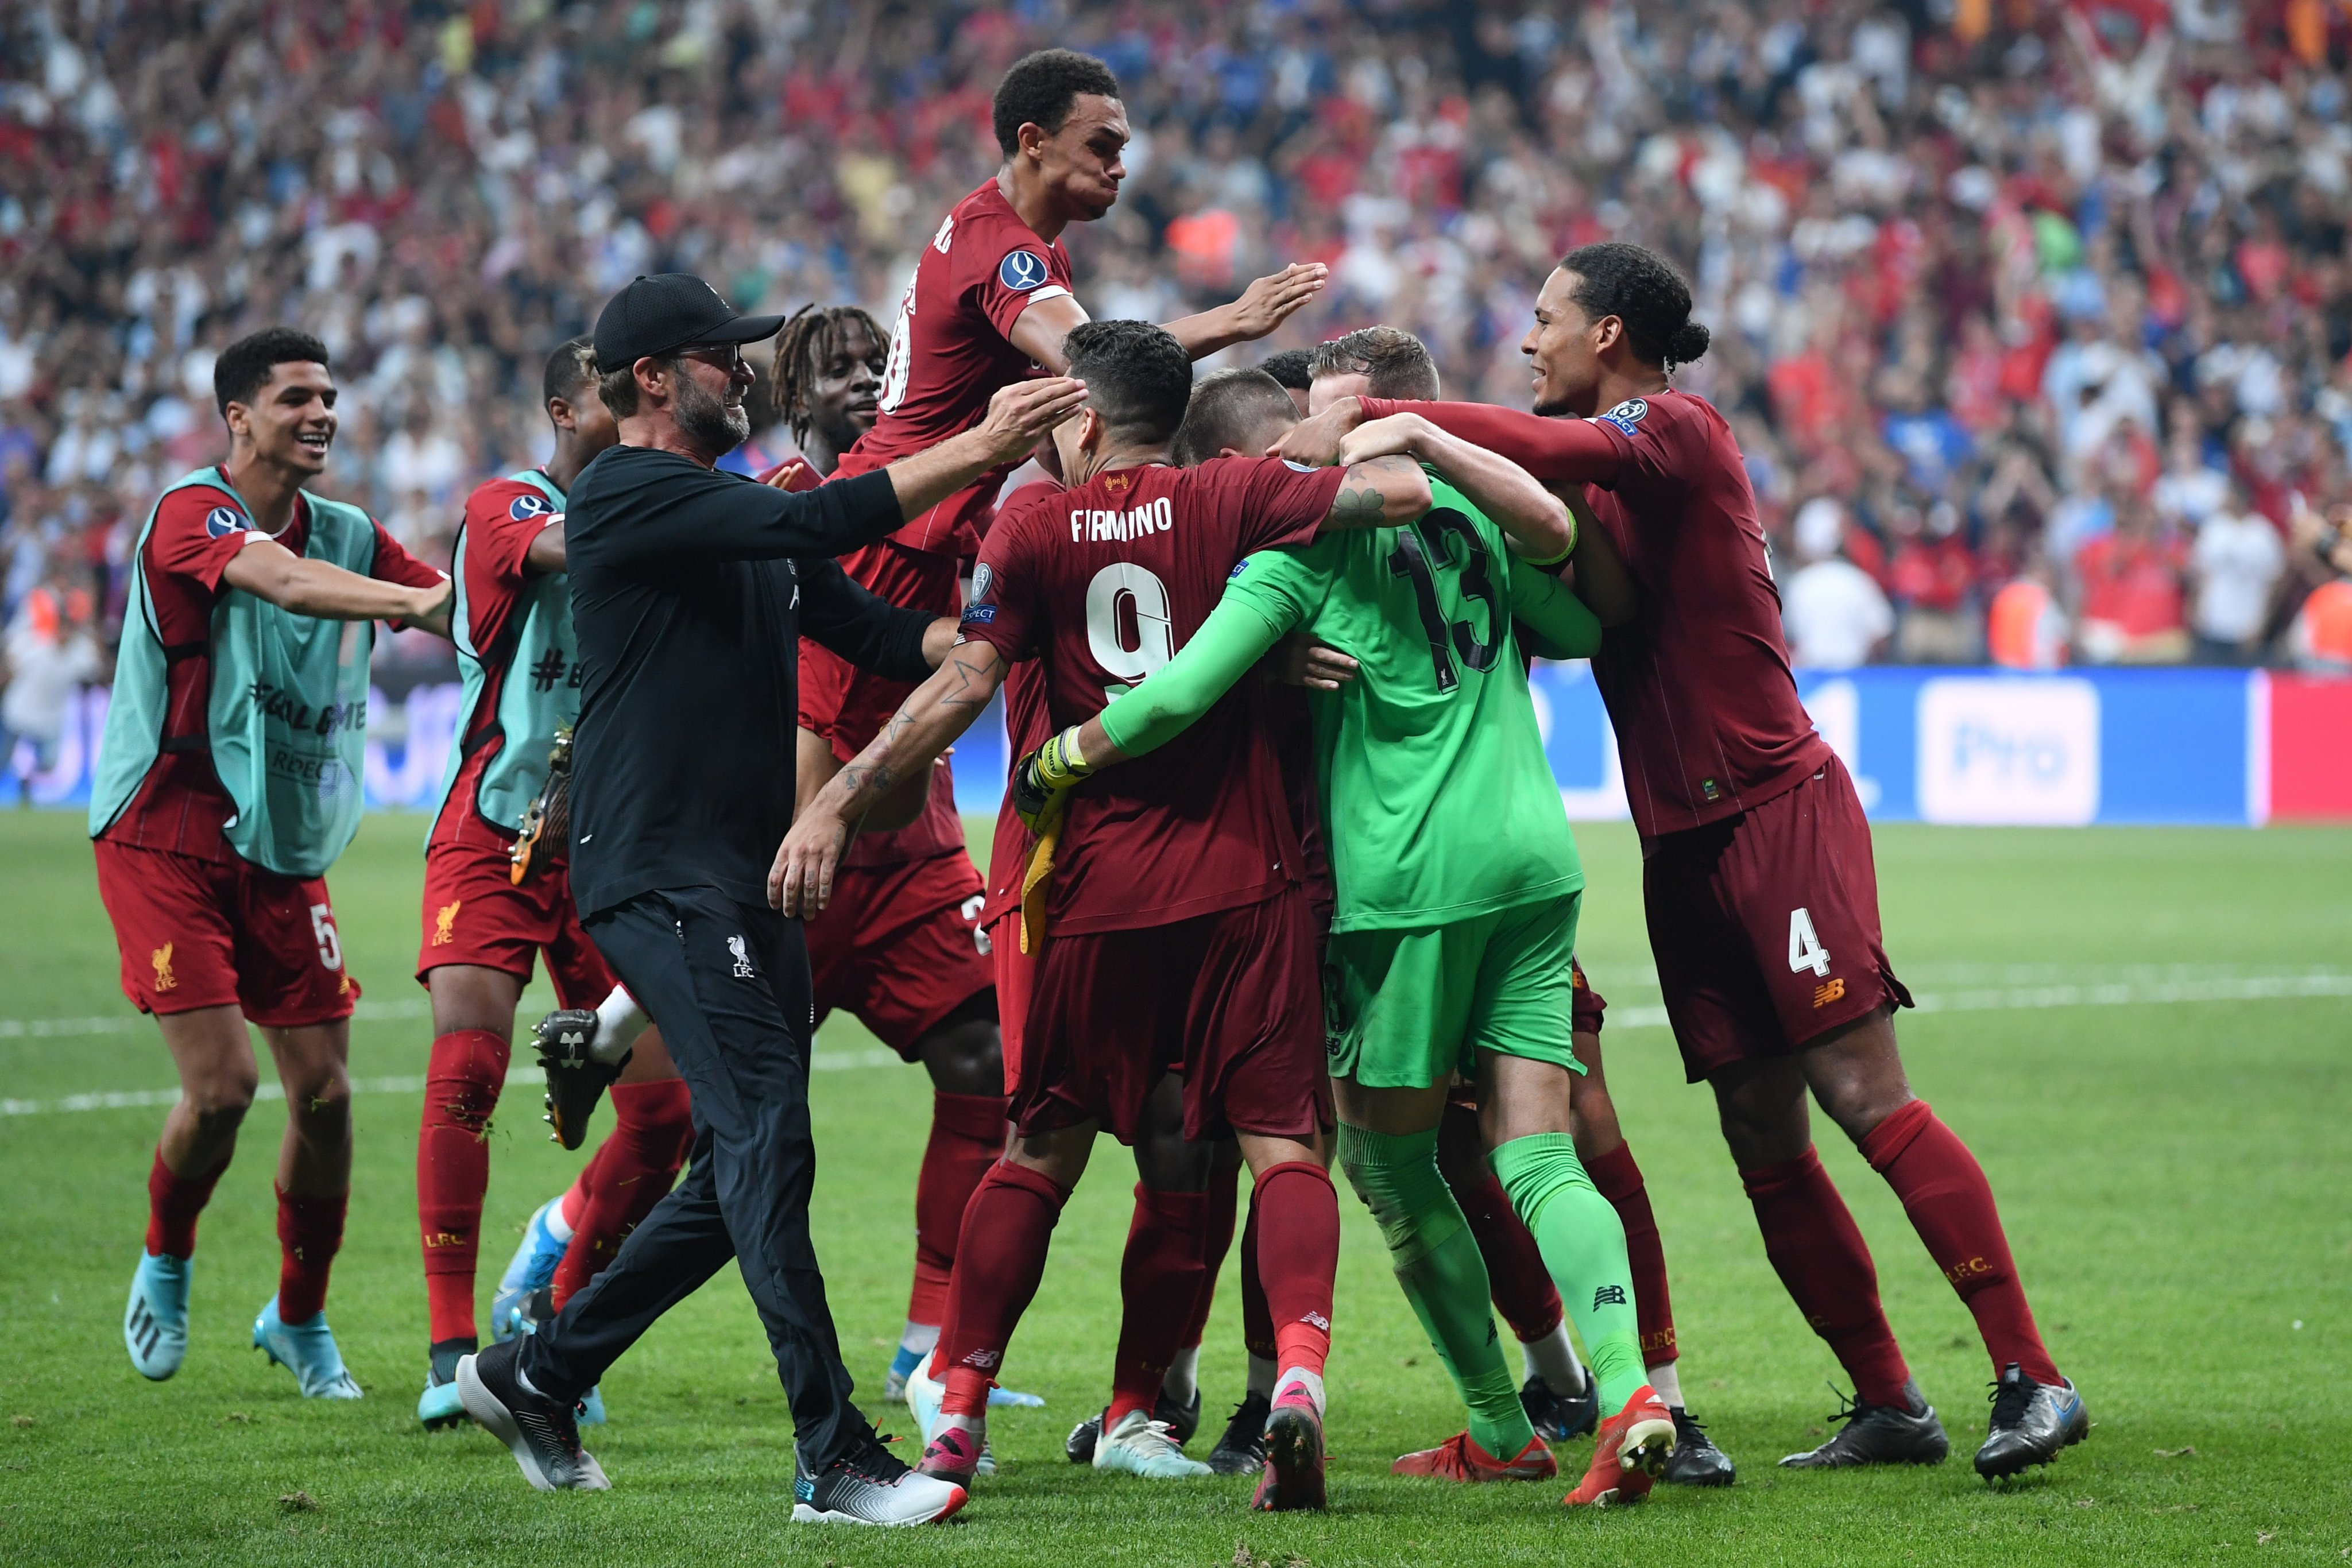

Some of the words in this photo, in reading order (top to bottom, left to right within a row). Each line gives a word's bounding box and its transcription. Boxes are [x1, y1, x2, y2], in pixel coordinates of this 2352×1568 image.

[1070, 497, 1173, 543] FIRMINO
[1086, 562, 1175, 705] 9
[1387, 506, 1503, 695] 13
[733, 967, 755, 978] LFC
[1789, 907, 1831, 978] 4
